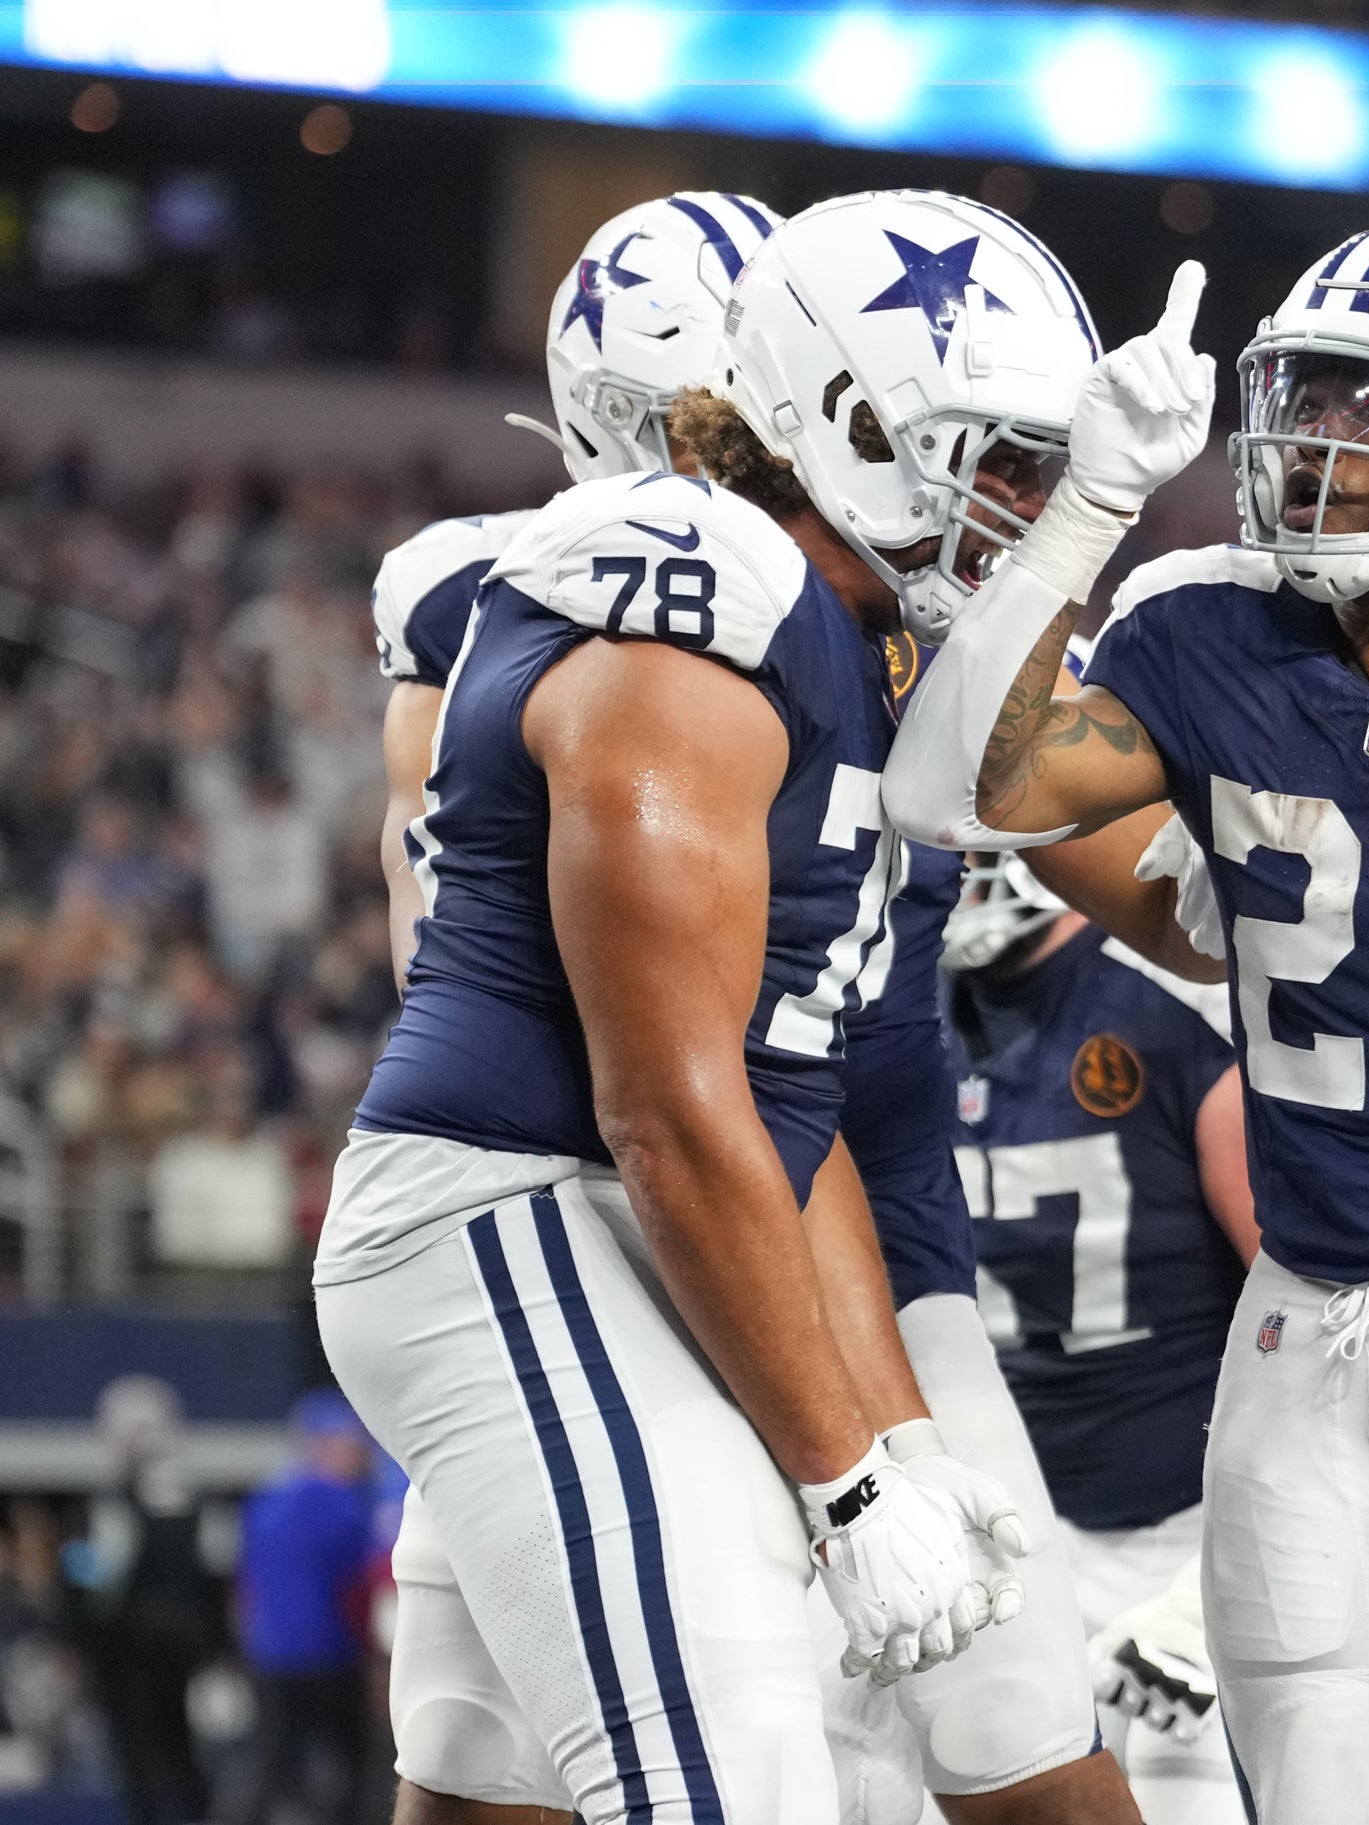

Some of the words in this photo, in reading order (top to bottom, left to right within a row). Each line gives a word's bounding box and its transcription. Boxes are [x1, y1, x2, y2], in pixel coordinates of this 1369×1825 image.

[590, 556, 717, 651] 78
[764, 763, 901, 1058] 7
[826, 1472, 881, 1528] NIKE
